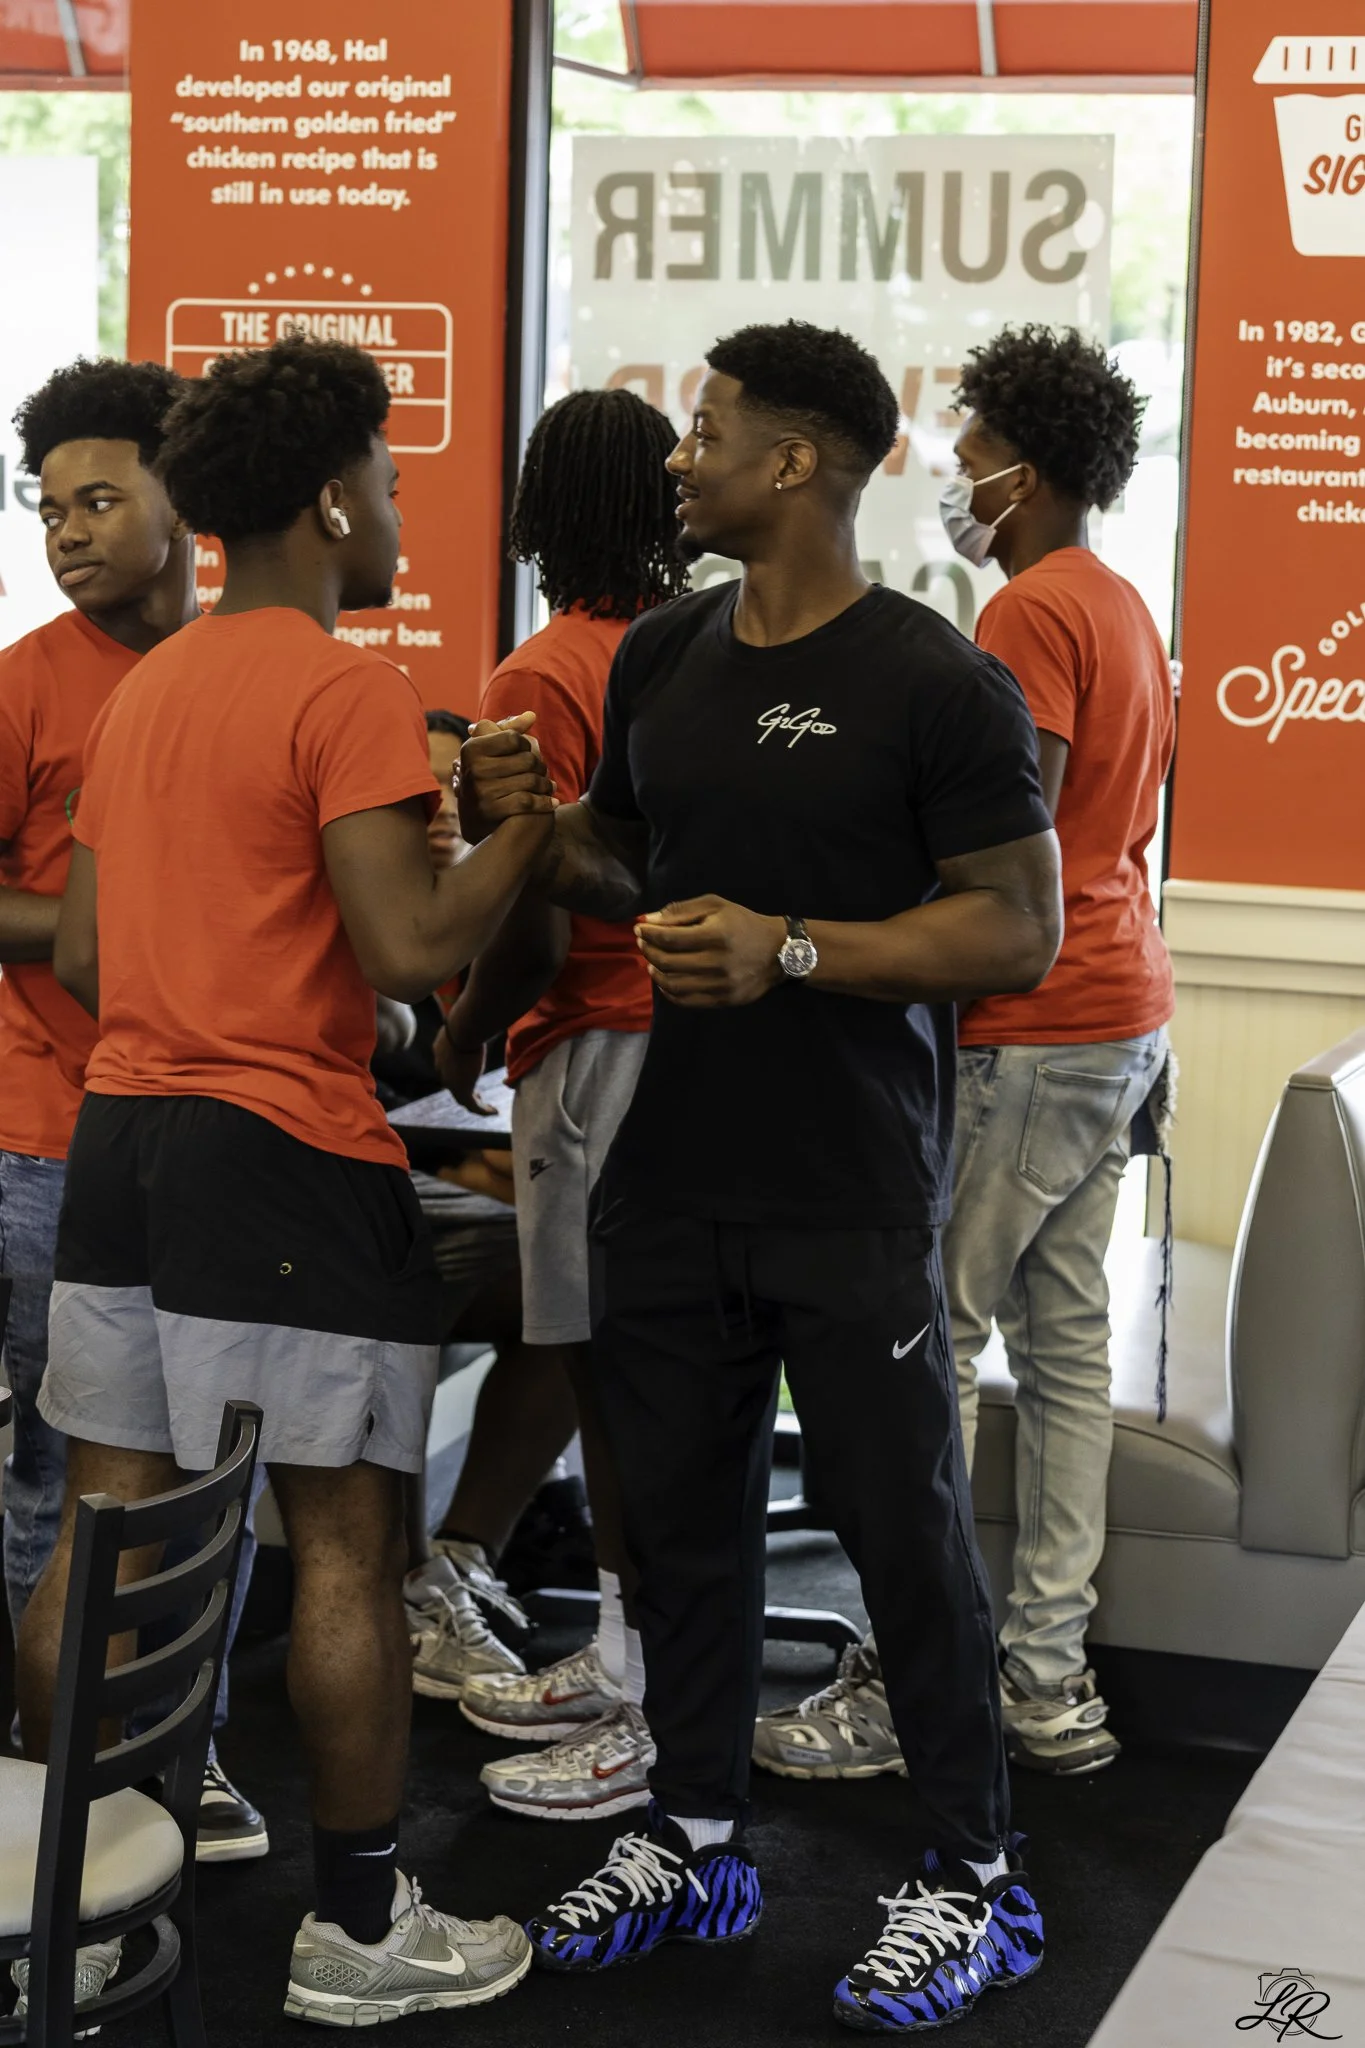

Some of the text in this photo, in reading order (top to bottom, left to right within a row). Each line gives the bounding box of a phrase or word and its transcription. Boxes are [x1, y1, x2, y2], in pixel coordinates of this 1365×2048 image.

[239, 37, 388, 65] In 1968, Hal
[175, 73, 452, 104] developed our original
[293, 110, 380, 140] golden
[186, 145, 438, 175] chicken recipe that is
[211, 180, 411, 211] still in use today.
[220, 311, 398, 347] THE ORIGINAL
[1238, 319, 1265, 342] In
[1273, 320, 1344, 347] 1982,
[1252, 391, 1357, 419] Auburn,
[1235, 425, 1361, 458] becoming
[333, 621, 444, 648] nger box
[1318, 601, 1365, 656] GOL
[1216, 644, 1365, 744] Spec
